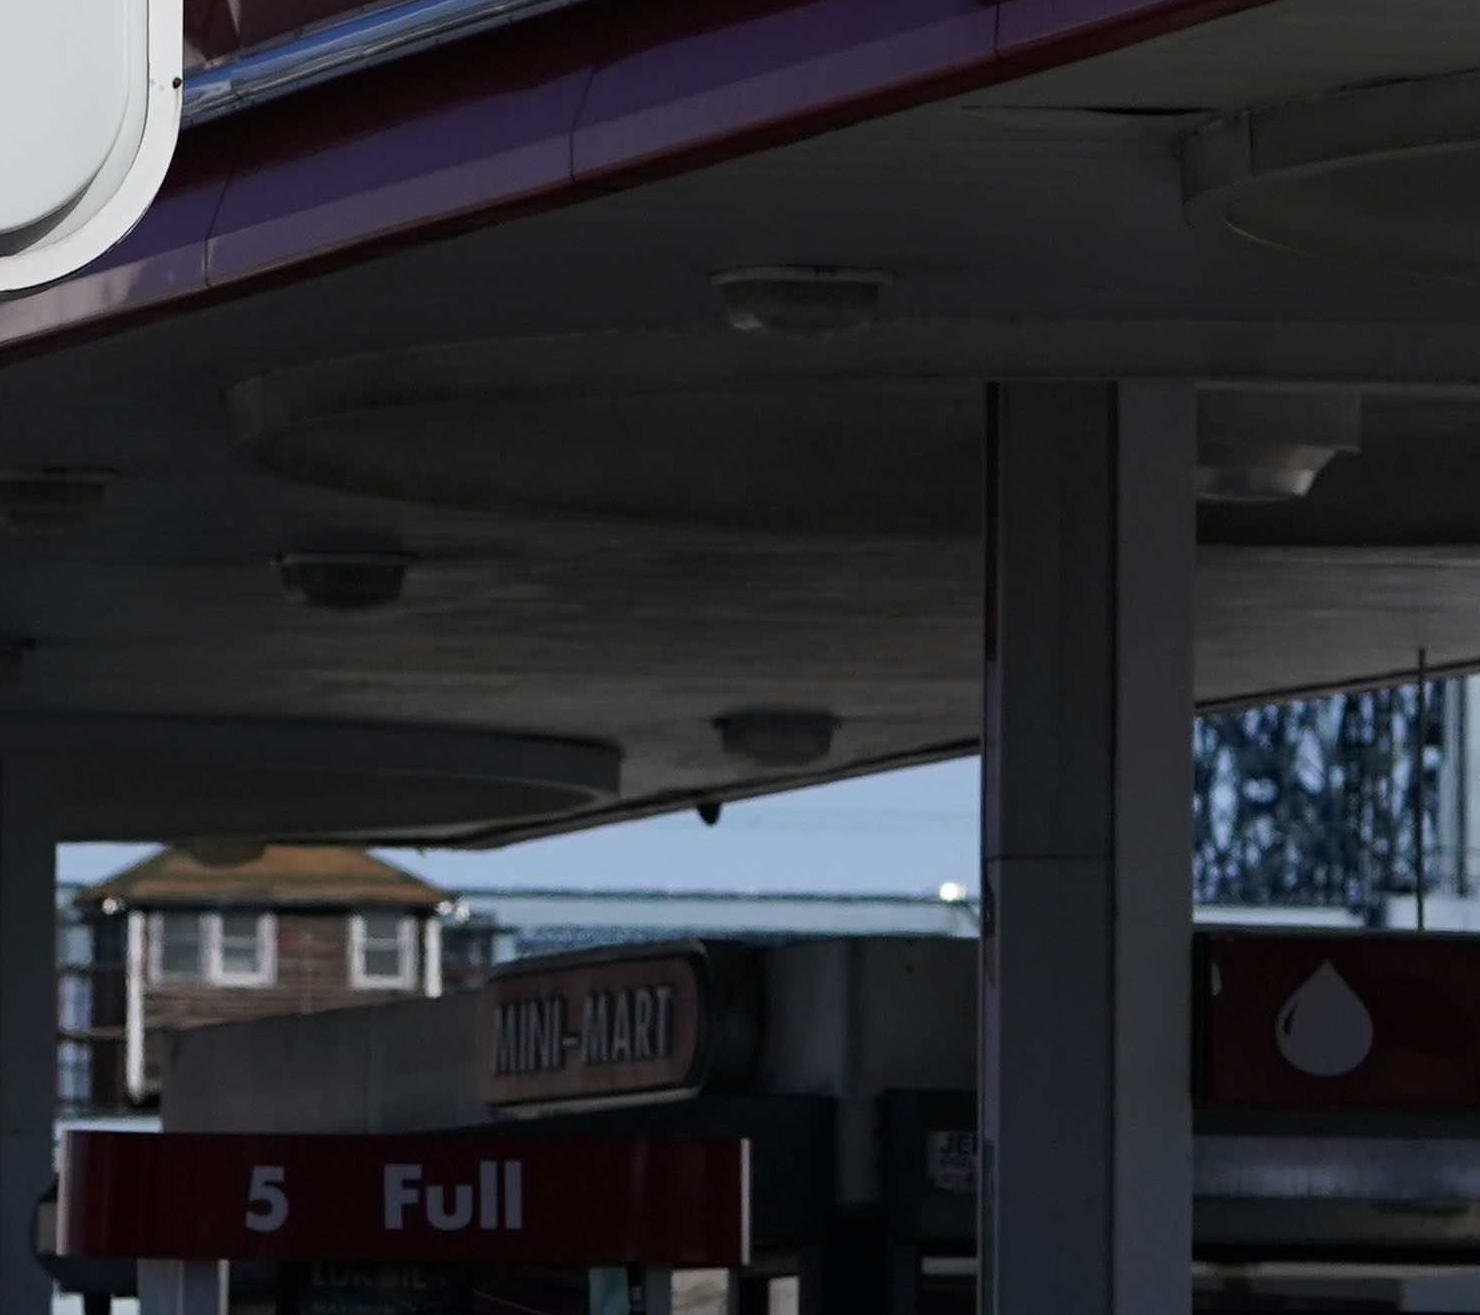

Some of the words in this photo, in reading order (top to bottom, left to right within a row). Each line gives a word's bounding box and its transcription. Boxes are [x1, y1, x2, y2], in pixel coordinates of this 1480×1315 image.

[494, 985, 676, 1075] MINI-MART
[245, 1165, 289, 1232] 5
[382, 1160, 524, 1231] Full
